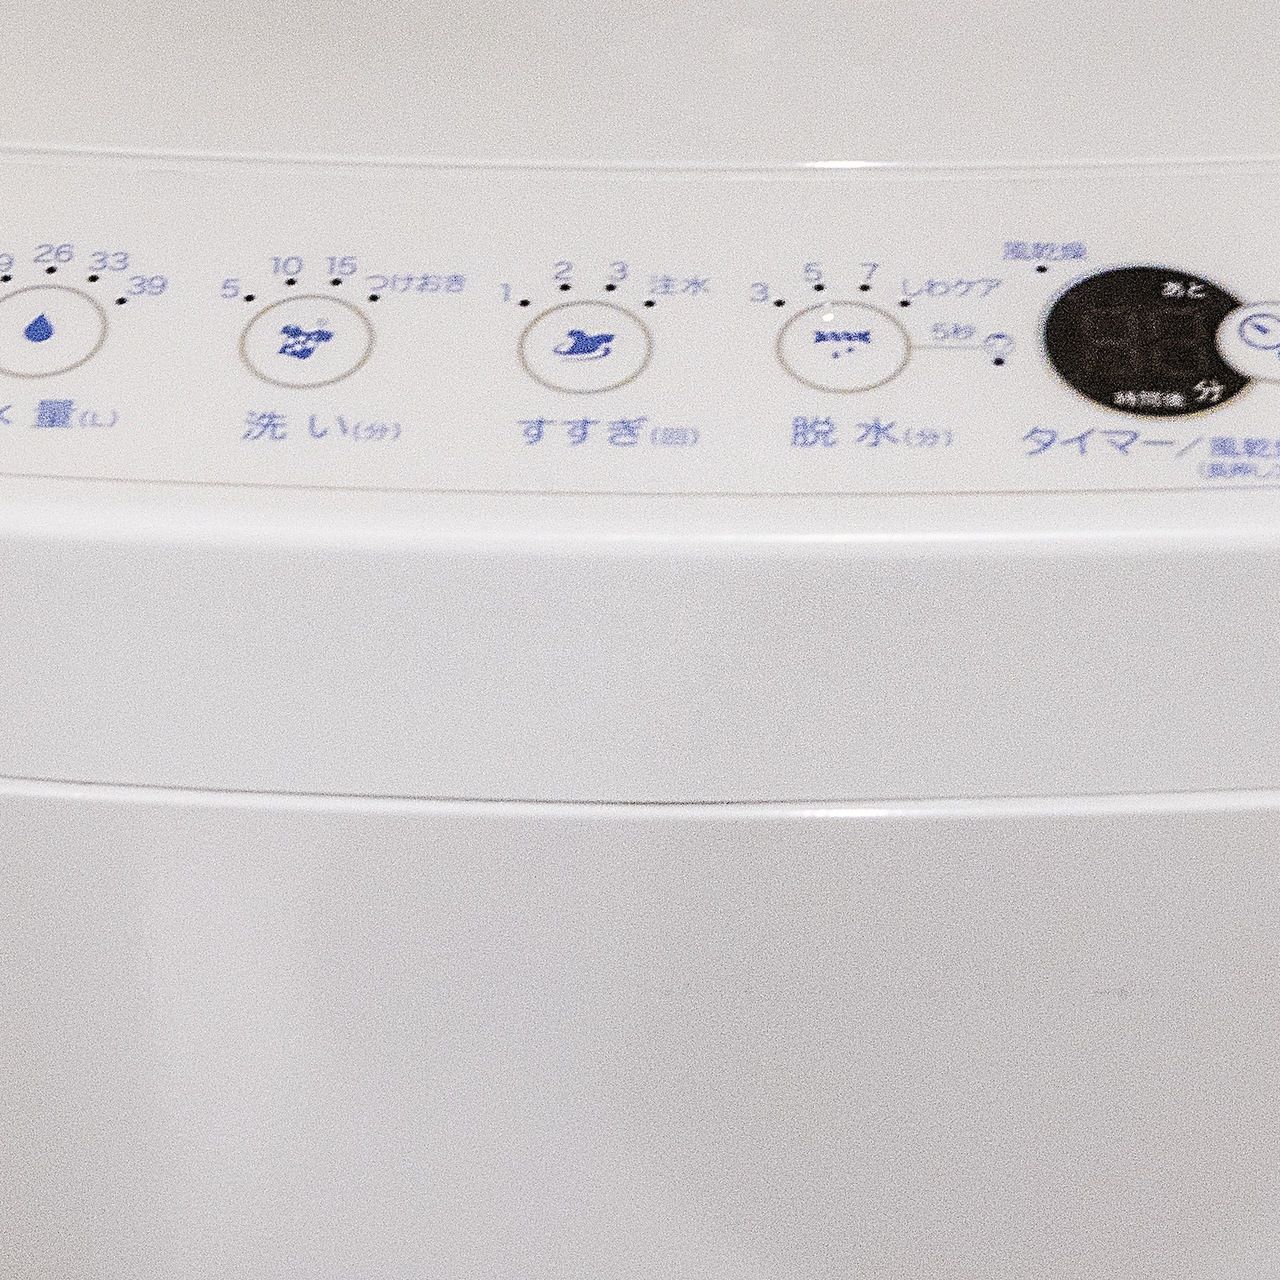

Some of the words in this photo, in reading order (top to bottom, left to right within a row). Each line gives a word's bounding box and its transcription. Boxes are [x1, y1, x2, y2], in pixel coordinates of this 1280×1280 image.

[33, 244, 74, 263] 26
[88, 251, 129, 271] 33
[271, 256, 303, 276] 10
[327, 256, 357, 276] 15
[553, 261, 573, 281] 2
[609, 261, 628, 282] 3
[804, 262, 822, 281] 5
[861, 263, 880, 281] 7
[127, 275, 168, 296] 39
[221, 278, 240, 298] 5
[366, 274, 466, 293] つけおき
[501, 283, 511, 302] 1
[649, 275, 709, 295] 注水
[750, 282, 770, 302] 3
[902, 278, 1003, 298] しわケア
[1161, 280, 1207, 299] あと
[1193, 379, 1224, 402] 分
